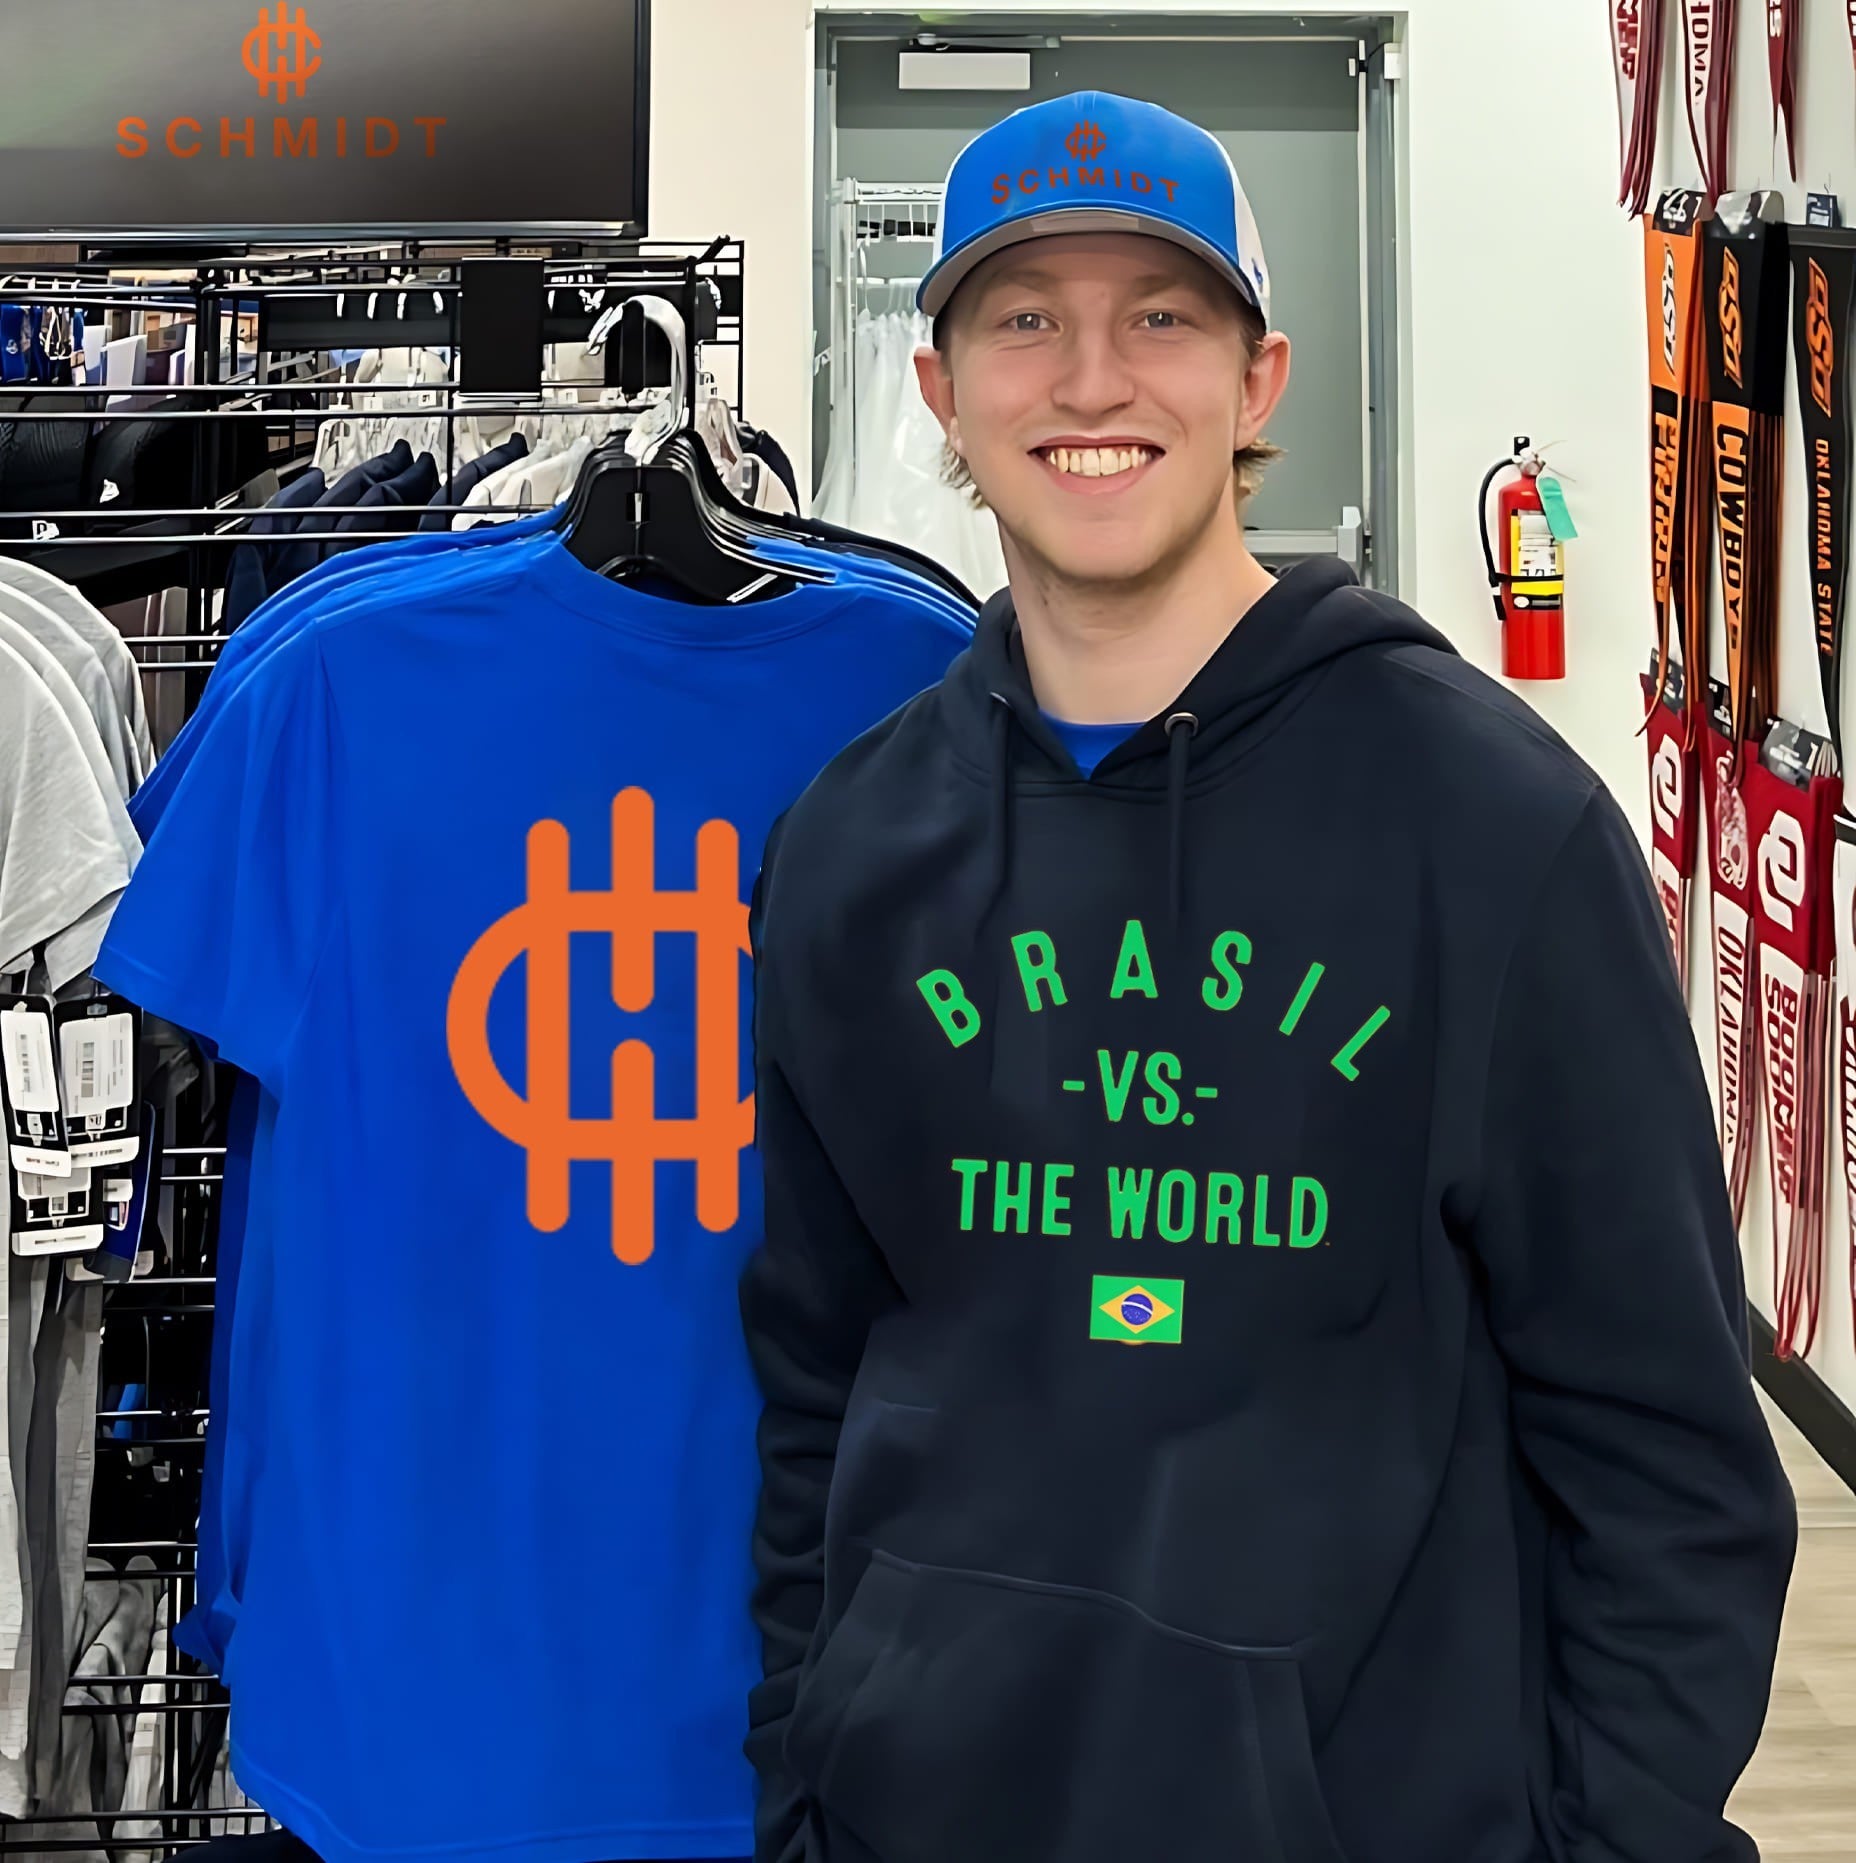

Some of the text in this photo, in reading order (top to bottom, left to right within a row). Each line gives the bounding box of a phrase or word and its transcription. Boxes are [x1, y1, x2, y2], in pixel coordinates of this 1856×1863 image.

[115, 117, 447, 159] SCHMIDT
[991, 167, 1180, 204] SCHMIDT
[1815, 438, 1832, 570] OKLAHOMA
[916, 920, 1391, 1082] BRASIL
[951, 1158, 1329, 1249] THE WORLD
